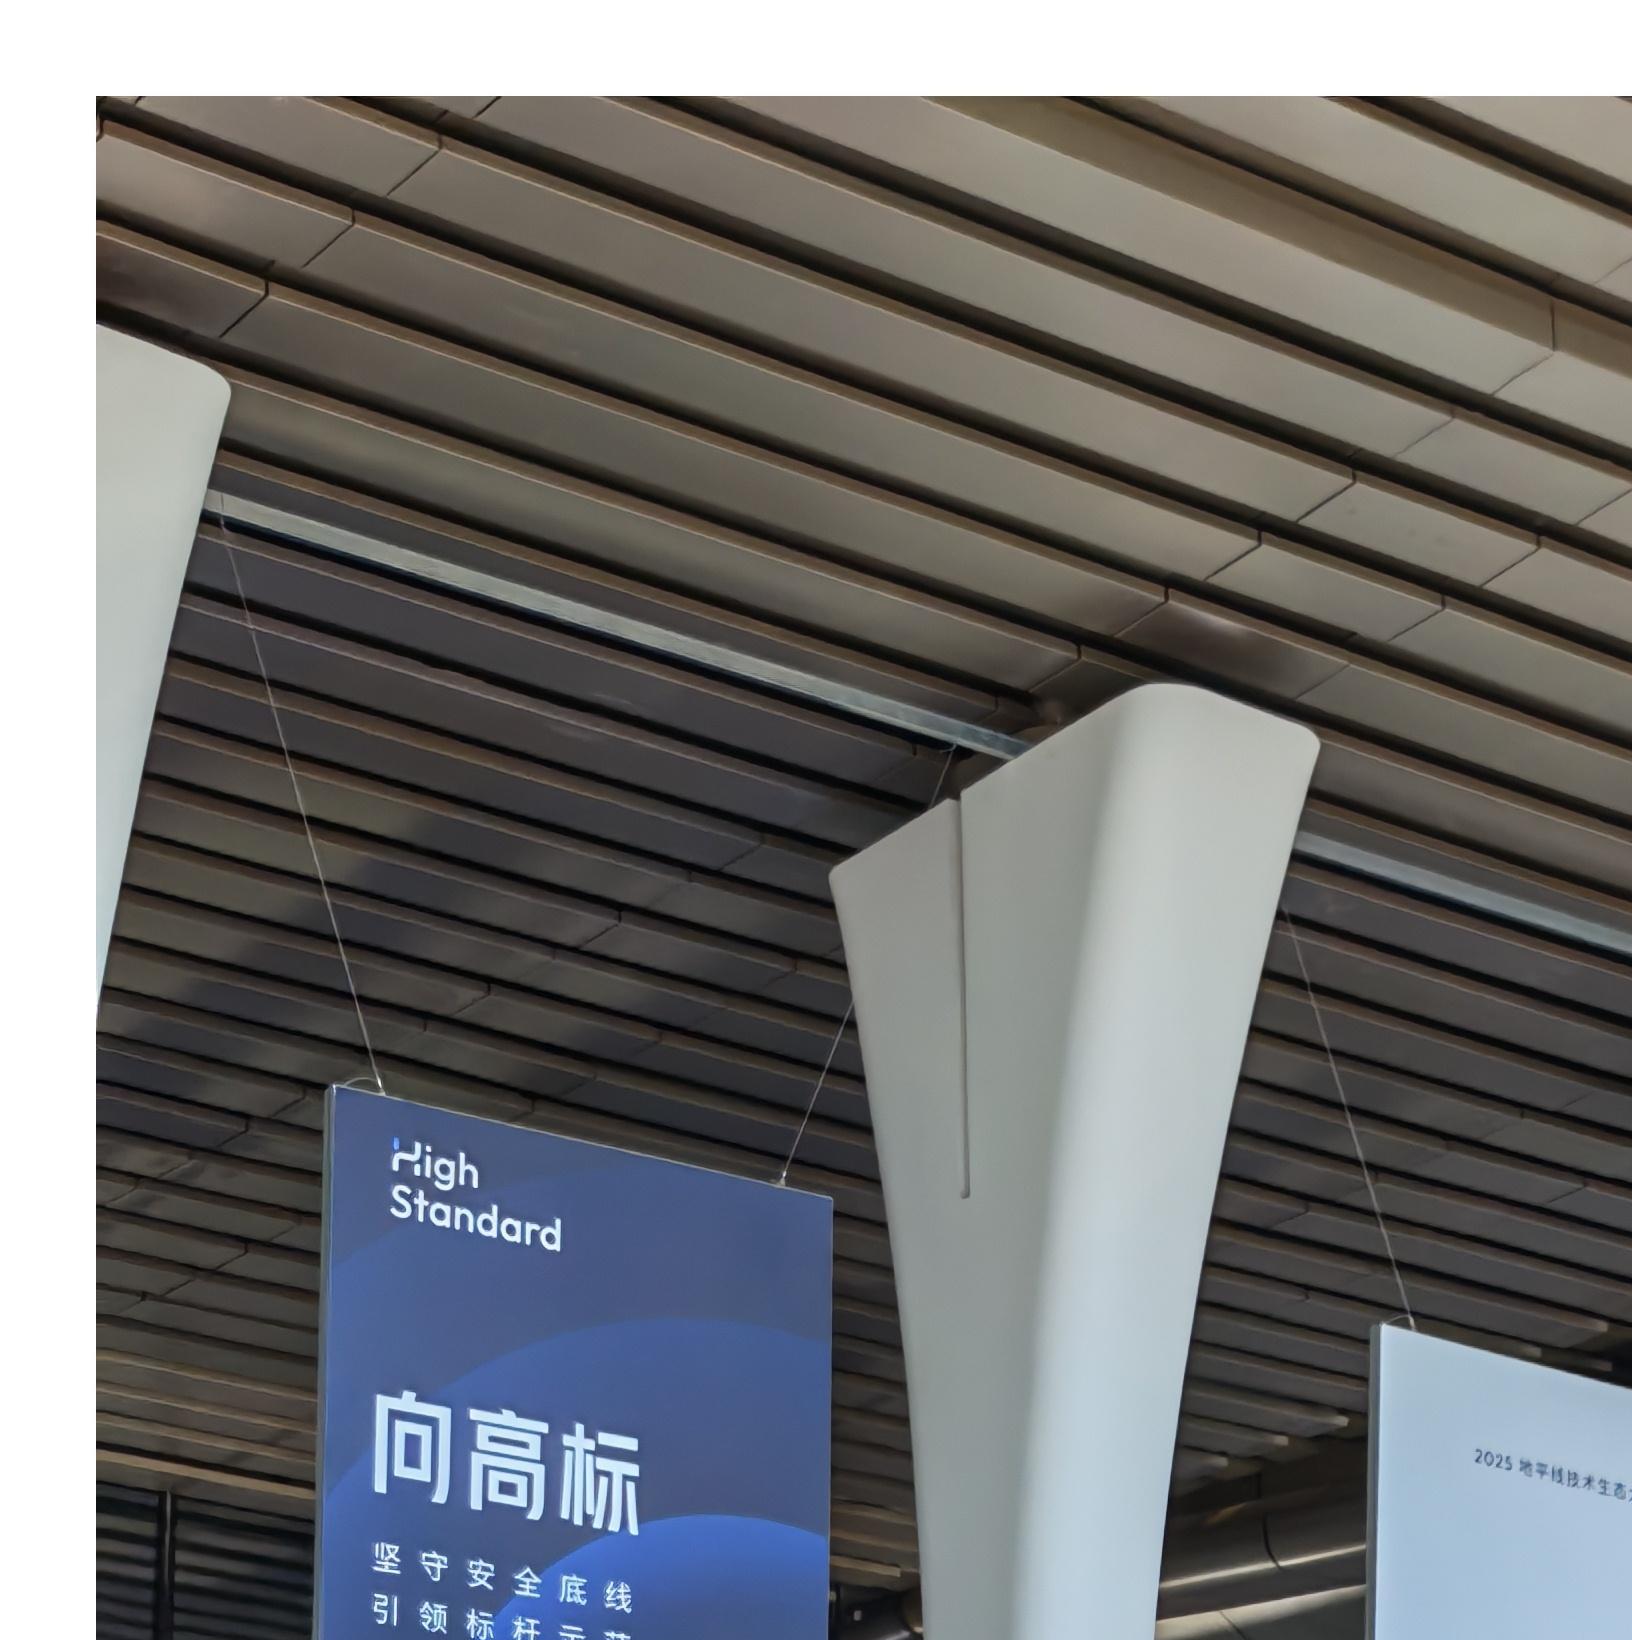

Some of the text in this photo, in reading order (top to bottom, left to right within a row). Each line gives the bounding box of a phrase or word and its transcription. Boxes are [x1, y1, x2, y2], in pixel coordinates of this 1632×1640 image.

[391, 1137, 480, 1189] High
[390, 1186, 562, 1253] Standard
[373, 1390, 640, 1537] 向高标
[1474, 1448, 1513, 1471] 2025
[372, 1541, 633, 1616] 坚守安全底线
